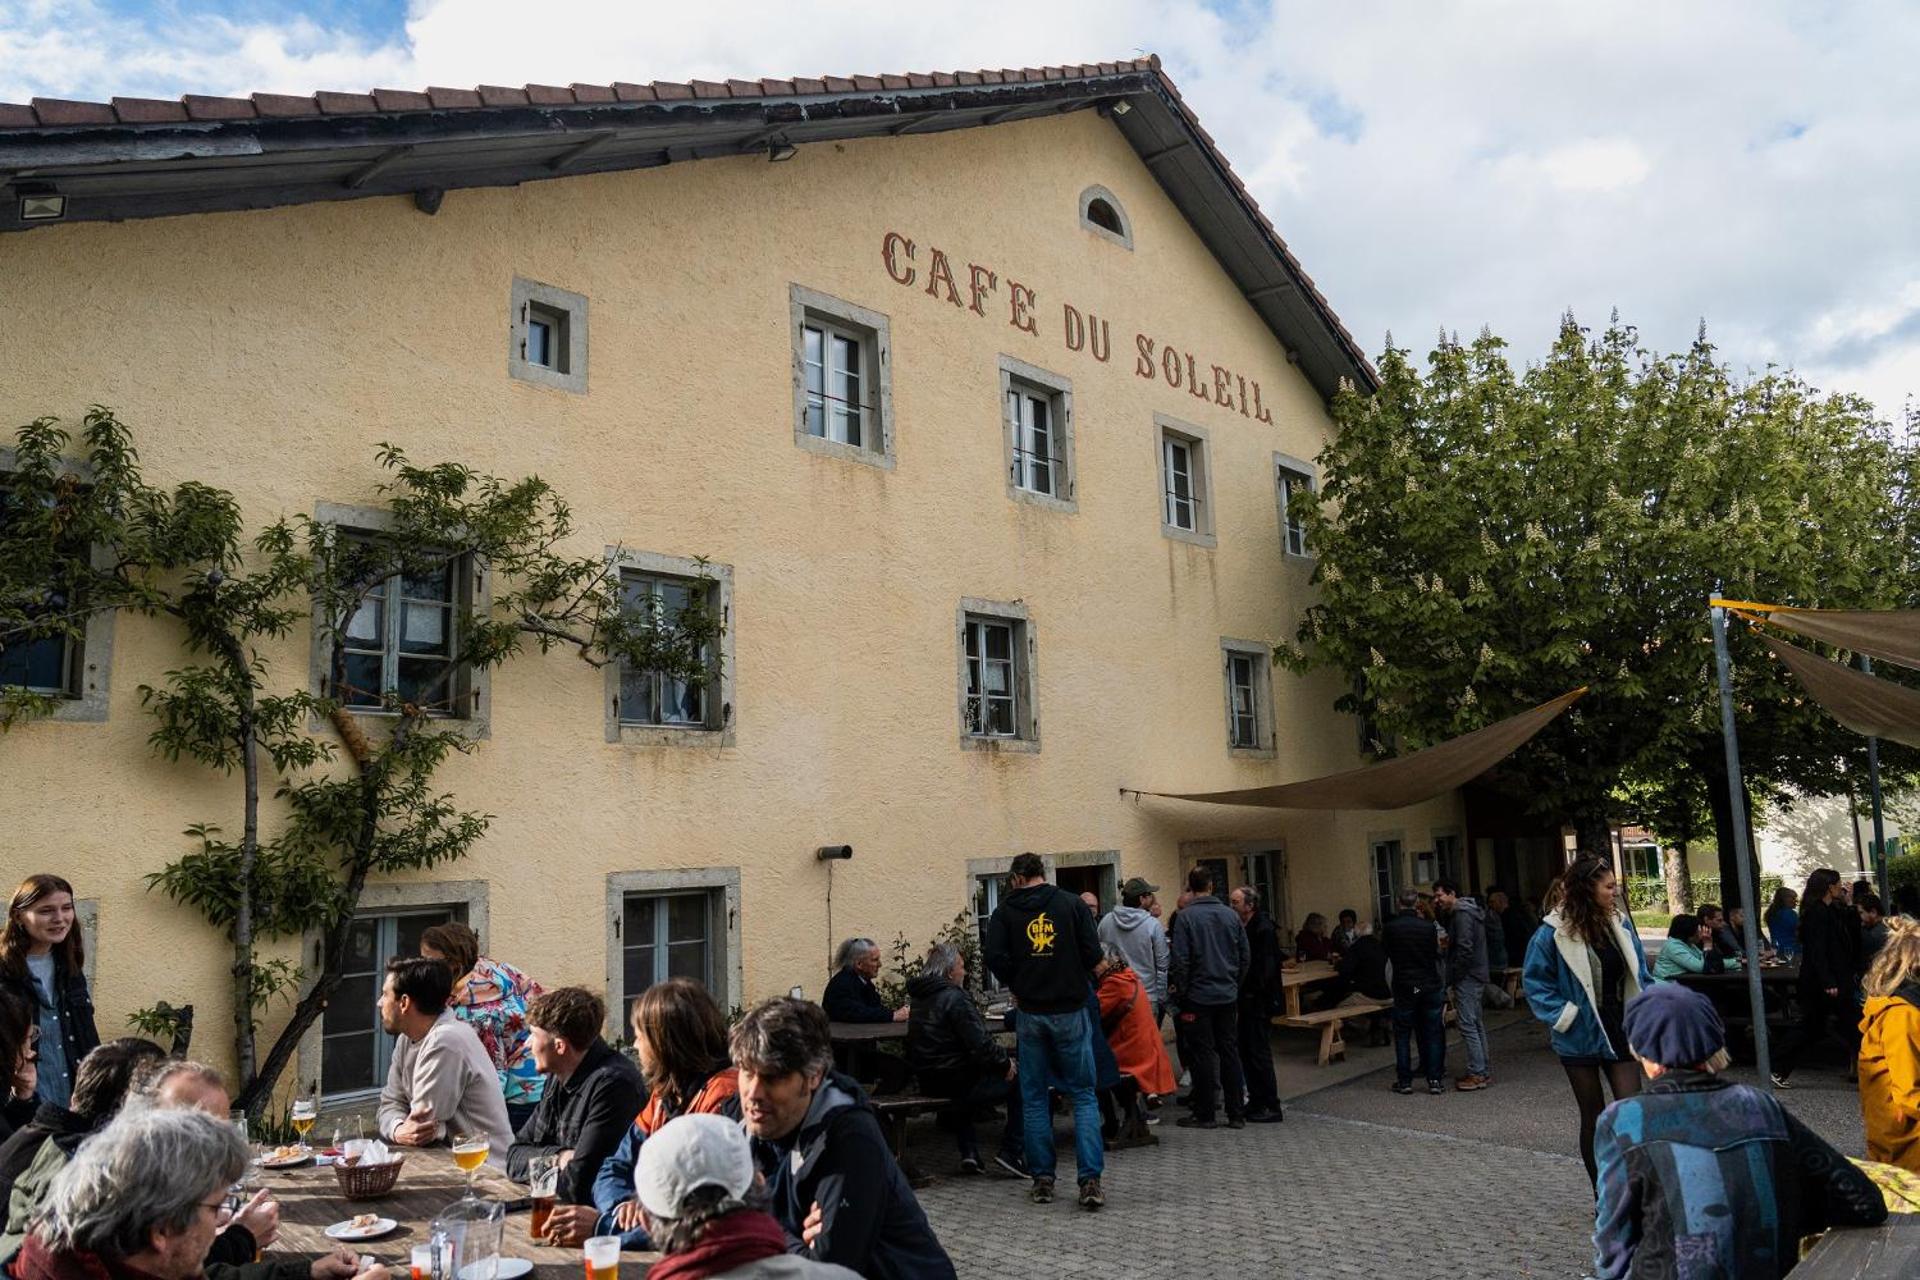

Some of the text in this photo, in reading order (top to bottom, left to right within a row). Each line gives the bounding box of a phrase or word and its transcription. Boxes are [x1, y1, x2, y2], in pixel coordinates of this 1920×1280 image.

[881, 231, 1274, 426] CAFE DU SOLEIL
[1032, 923, 1054, 933] BFM
